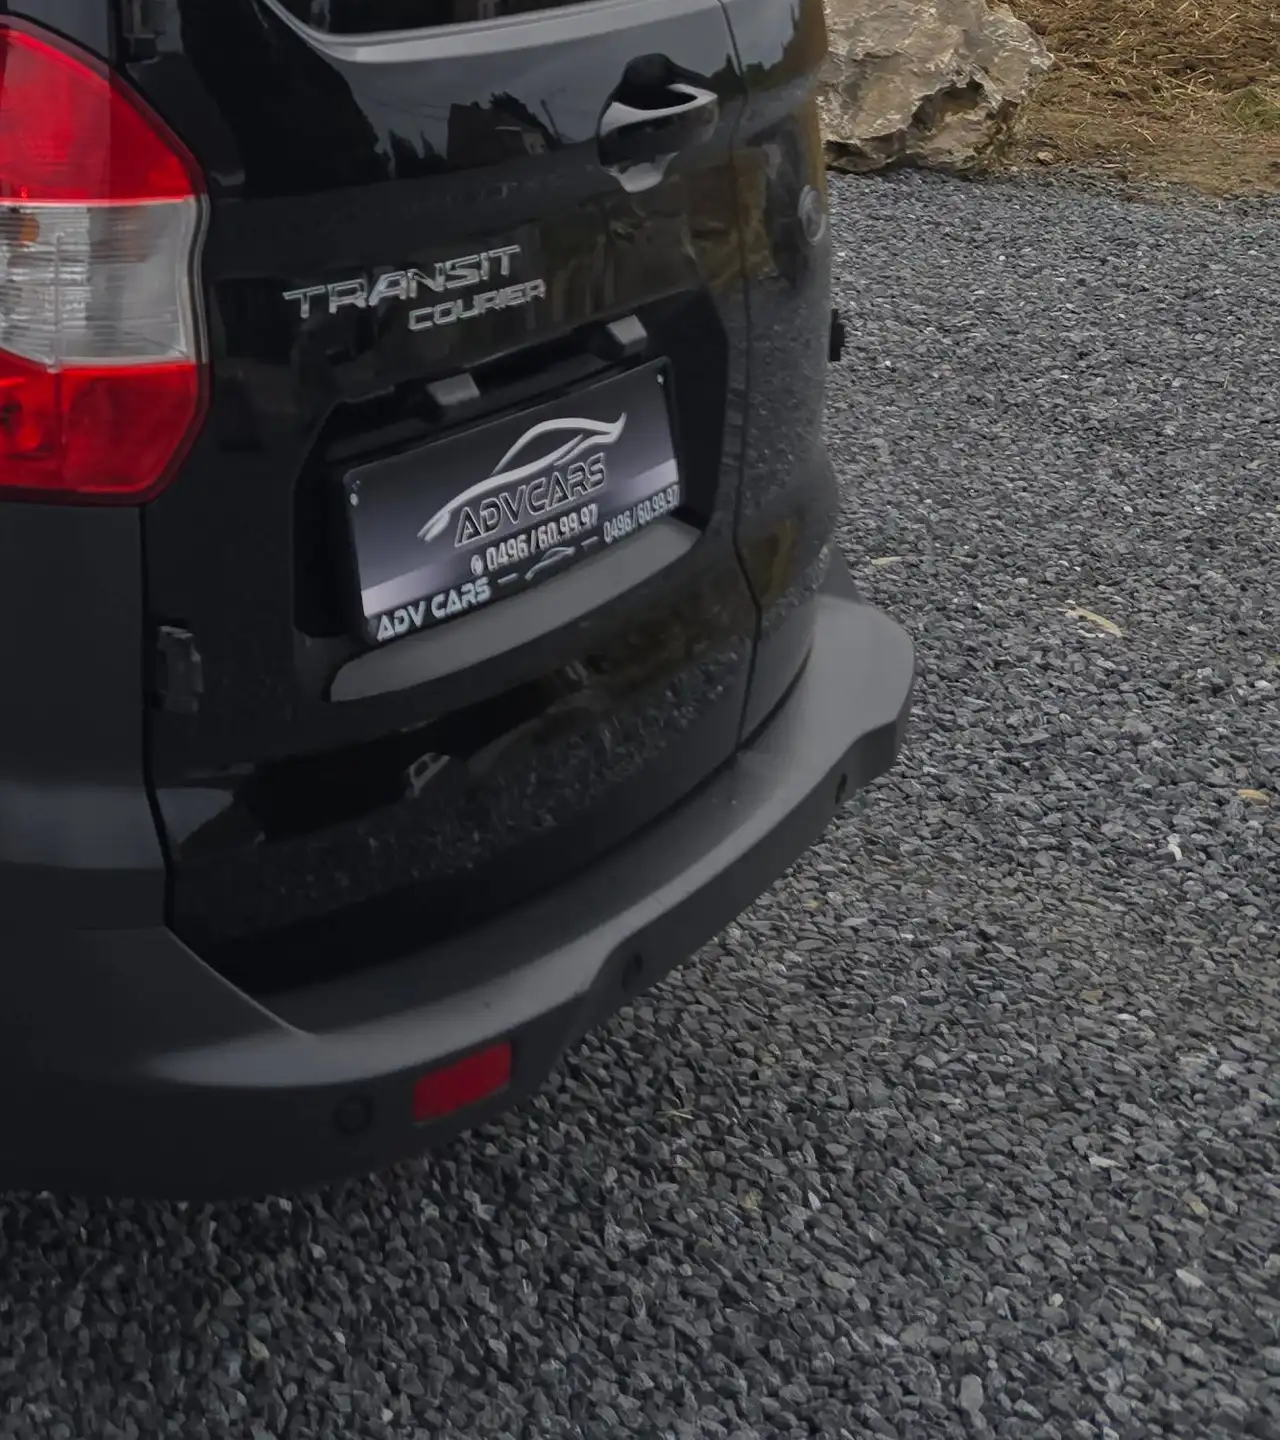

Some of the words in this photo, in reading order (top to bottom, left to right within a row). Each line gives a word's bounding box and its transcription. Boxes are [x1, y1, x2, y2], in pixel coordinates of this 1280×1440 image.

[282, 245, 521, 319] TRANSIT
[408, 278, 547, 331] COURIER
[454, 452, 606, 548] ADVCARS
[376, 600, 427, 642] ADV
[430, 576, 492, 620] CARS
